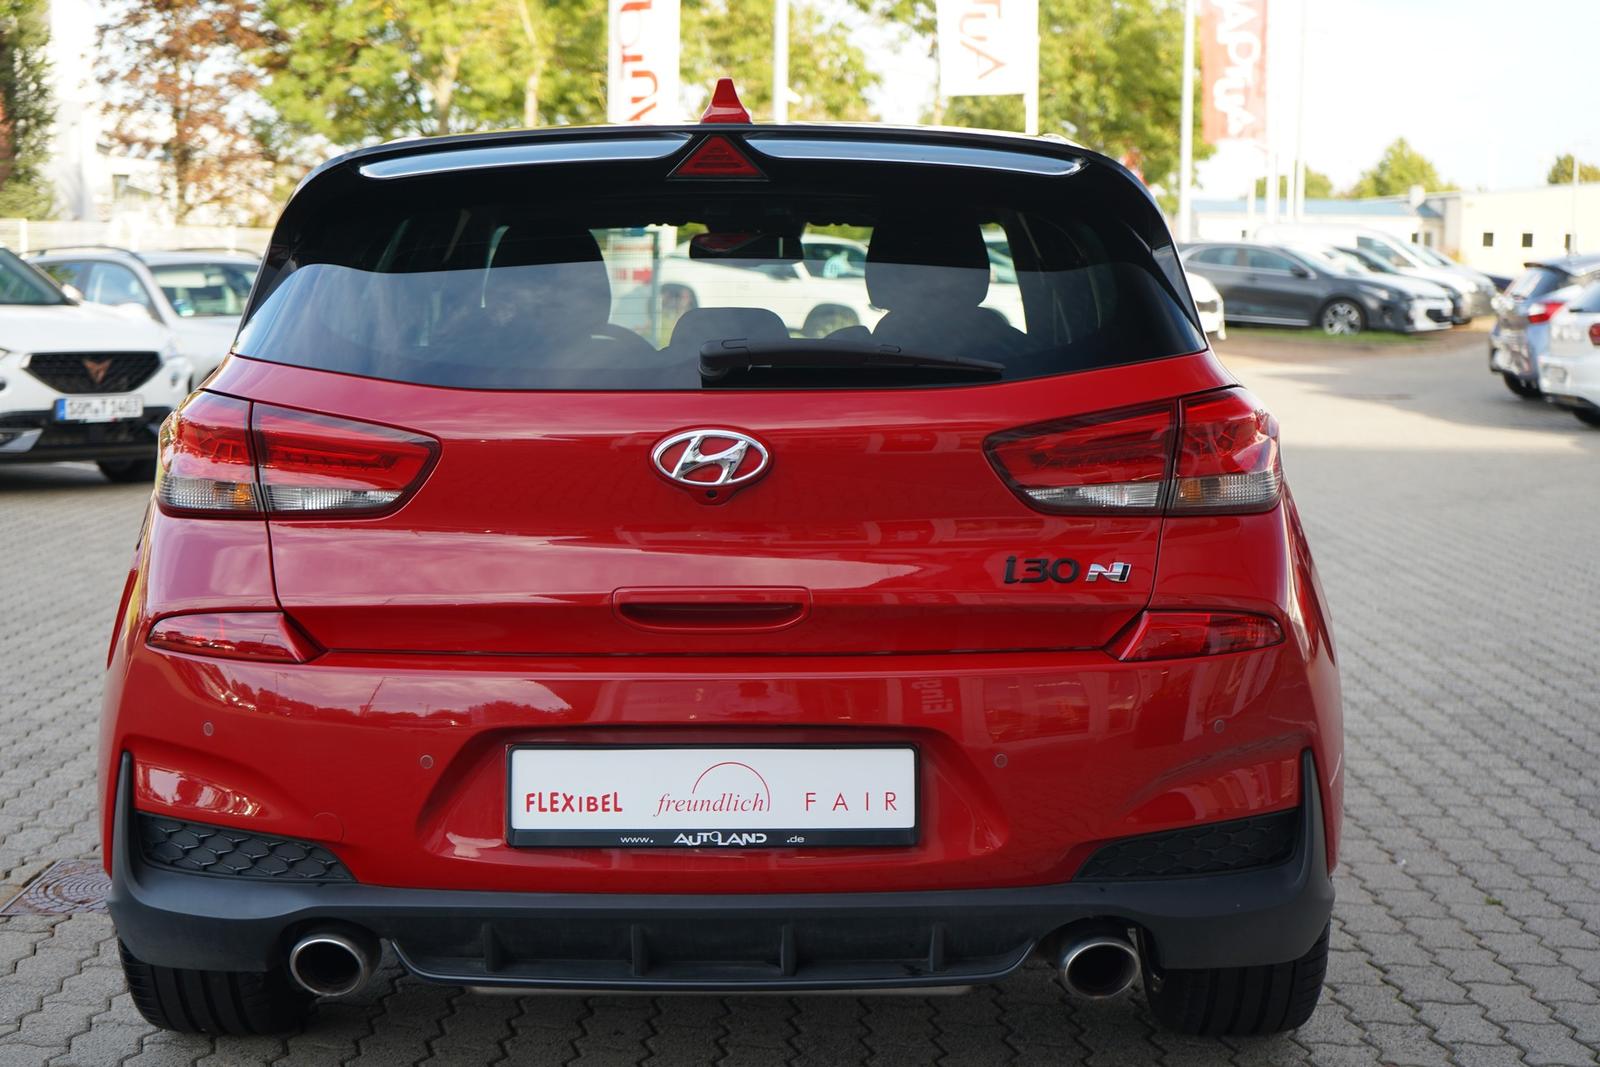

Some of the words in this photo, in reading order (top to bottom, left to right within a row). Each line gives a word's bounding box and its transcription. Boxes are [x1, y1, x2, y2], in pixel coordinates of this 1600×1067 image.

[1003, 555, 1081, 584] i30
[525, 791, 623, 813] FLEXIBEL
[652, 792, 764, 817] freundlich
[805, 791, 897, 811] FAIR
[673, 831, 767, 846] AUTOLAND
[786, 835, 805, 843] .de
